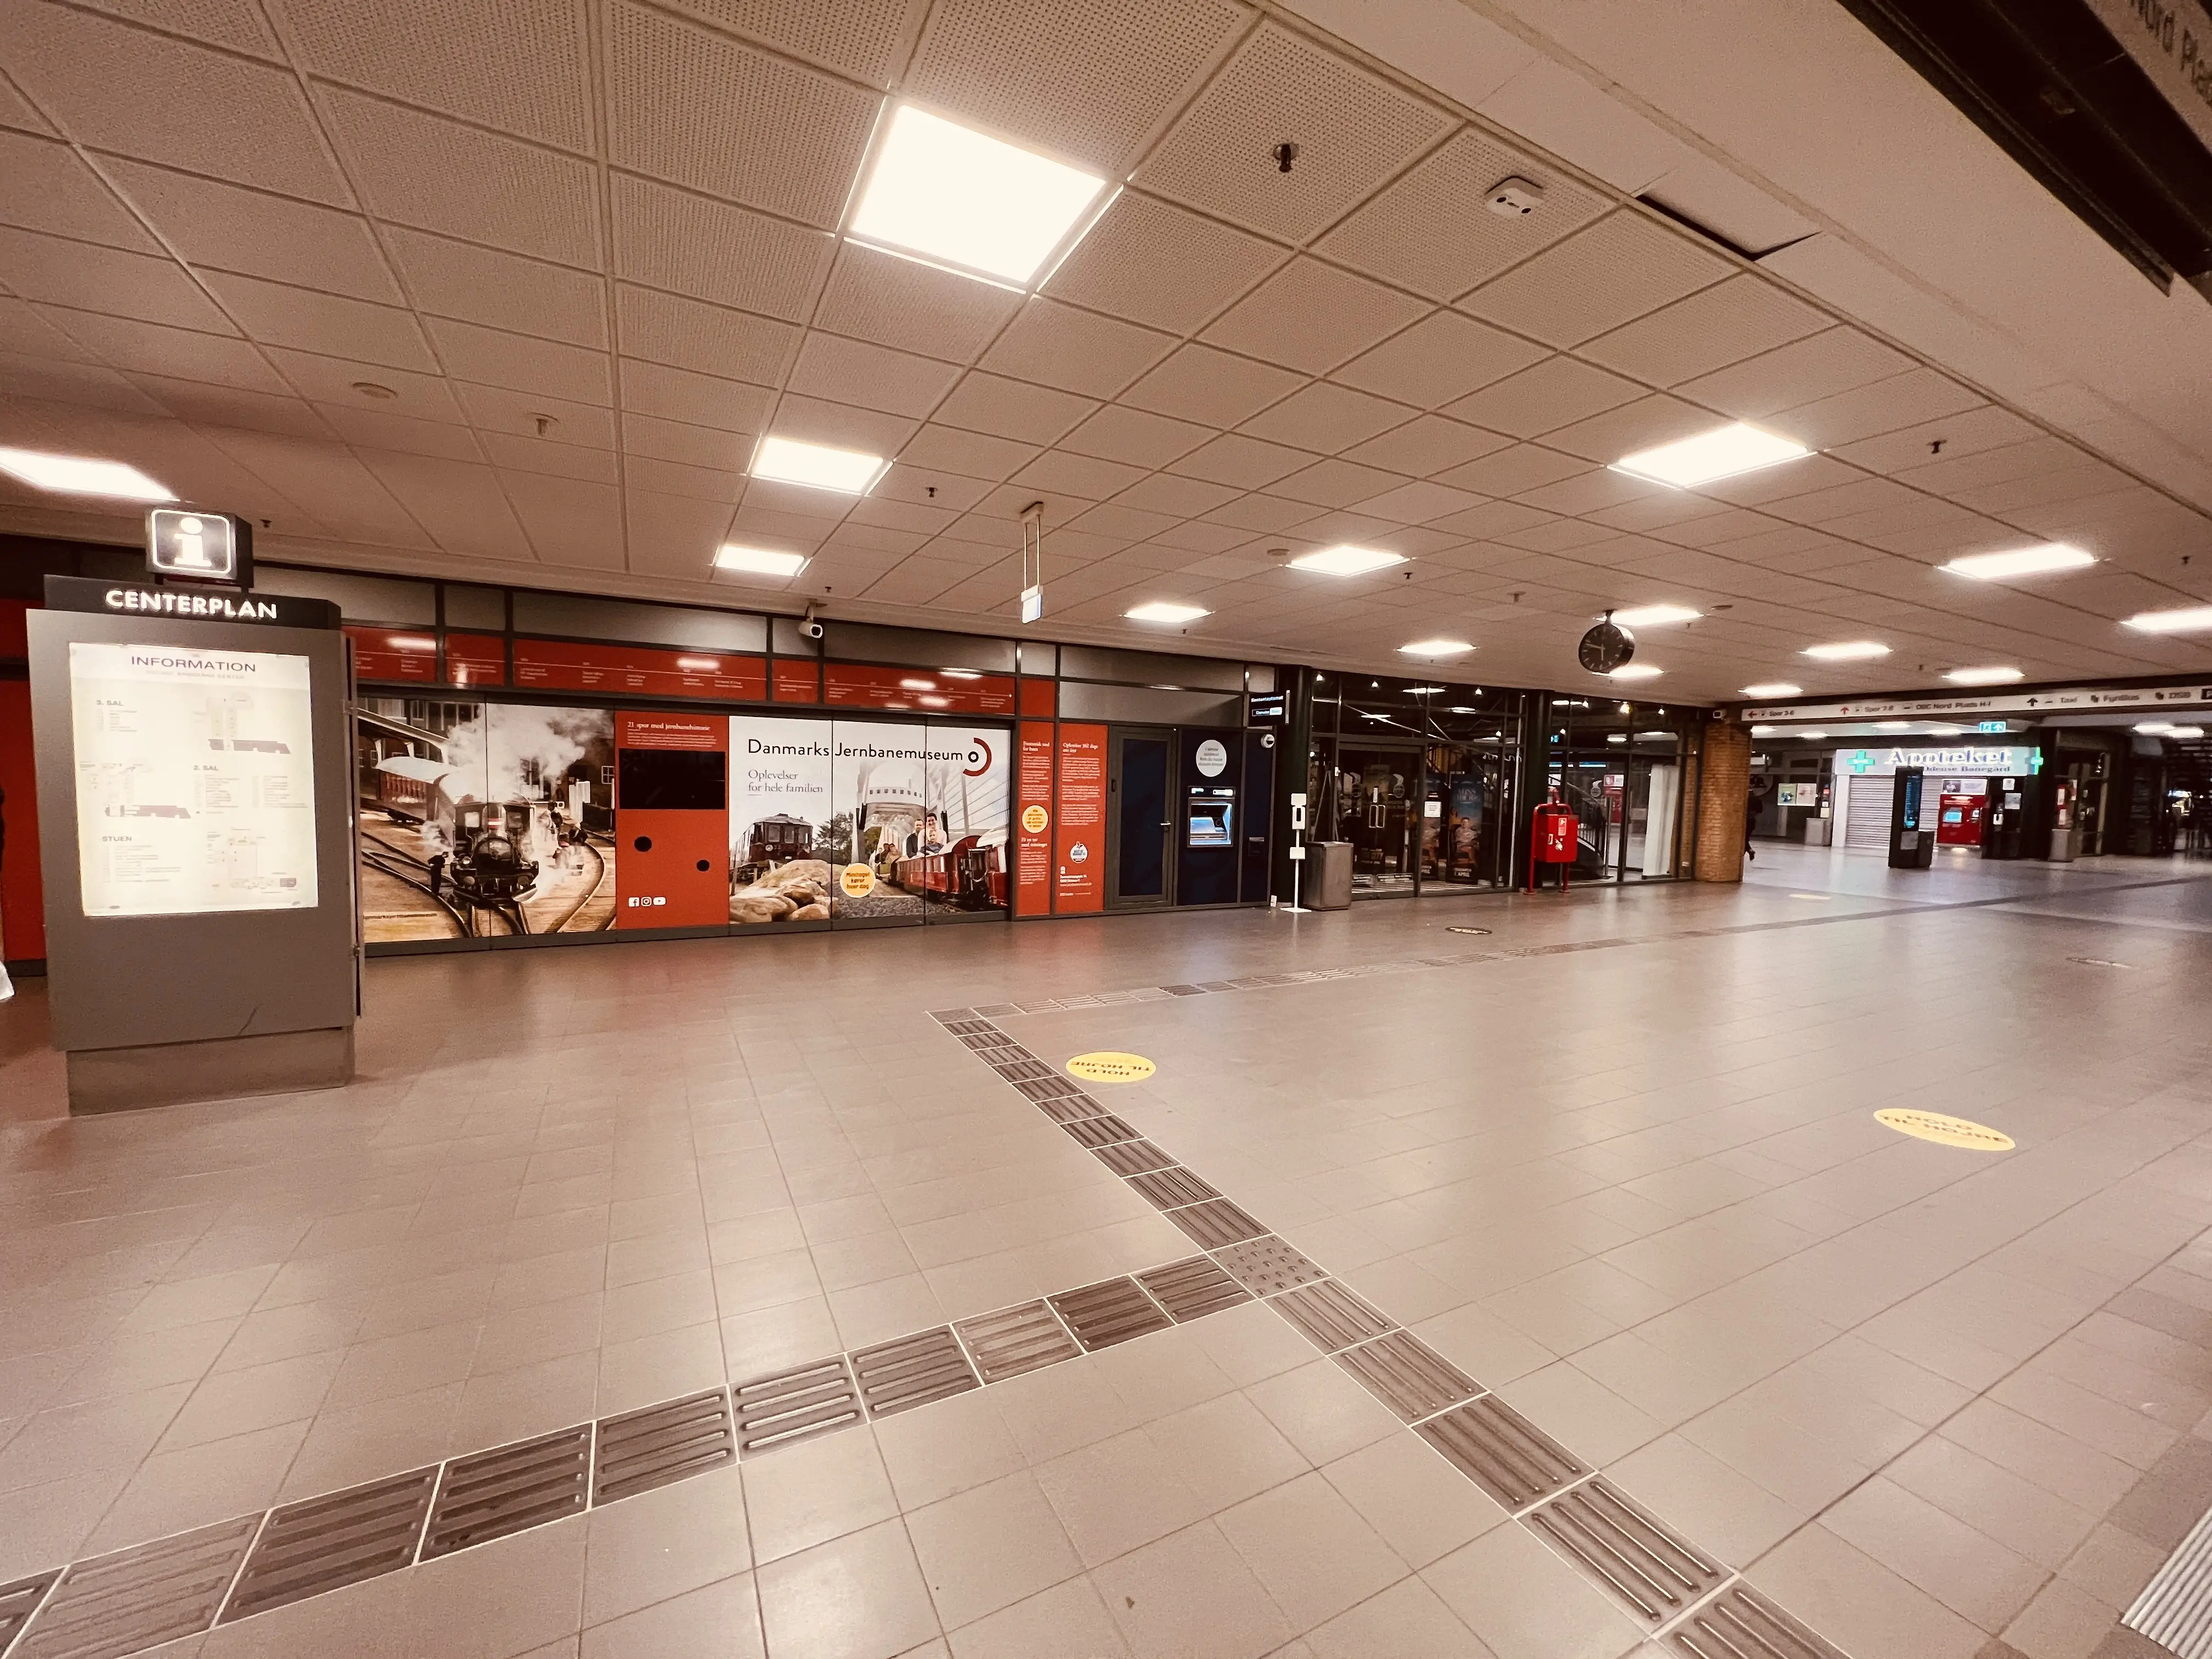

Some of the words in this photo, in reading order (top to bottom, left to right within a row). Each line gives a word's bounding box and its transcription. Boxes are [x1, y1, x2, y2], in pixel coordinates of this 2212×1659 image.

[105, 589, 278, 619] CENTERPLAN
[131, 656, 256, 673] INFORMATION
[748, 738, 830, 757] Danmarks
[834, 742, 963, 761] Jernbanemuseum
[1884, 747, 2013, 768] Apoteket
[748, 769, 798, 782] Oplevelser
[748, 783, 763, 793] for
[764, 783, 784, 792] hele
[786, 783, 823, 793] familien
